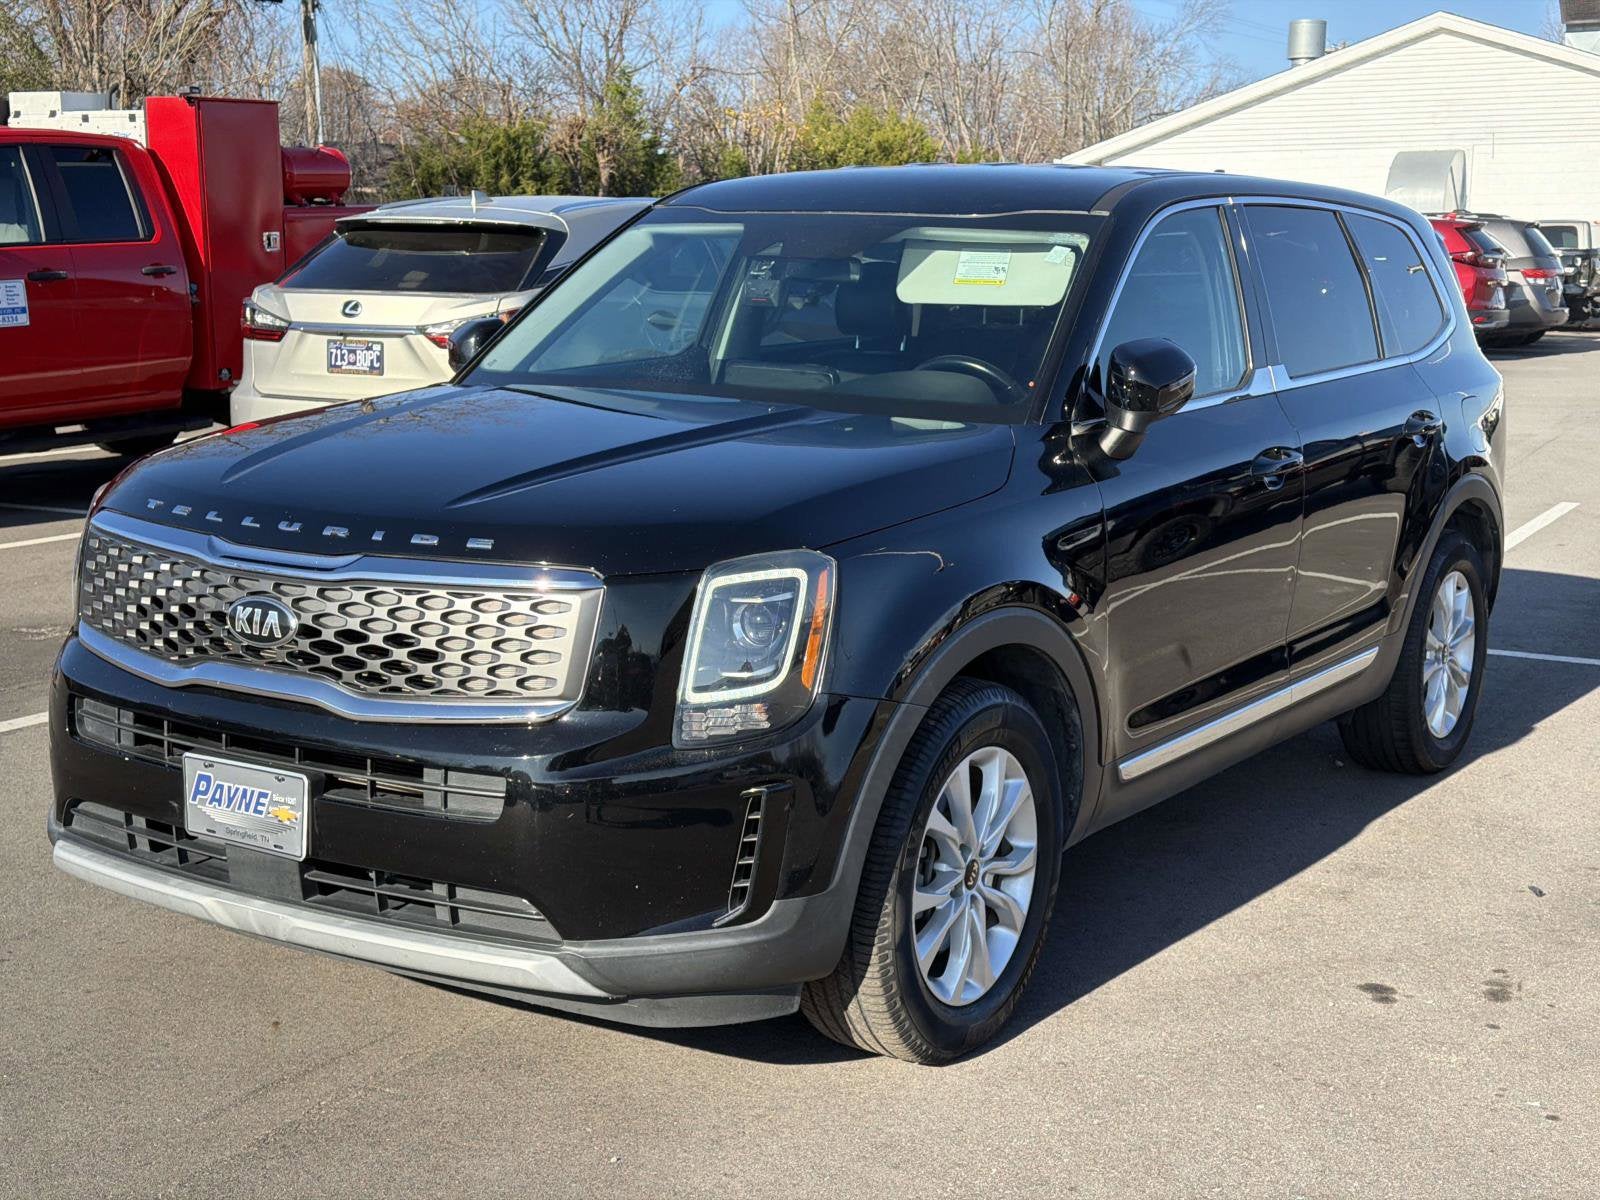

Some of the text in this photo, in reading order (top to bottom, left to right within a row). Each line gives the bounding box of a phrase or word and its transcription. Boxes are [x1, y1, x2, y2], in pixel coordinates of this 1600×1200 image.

[330, 349, 348, 366] 713
[147, 497, 496, 551] TELLURIDE
[235, 605, 282, 639] KIA
[189, 770, 272, 818] PAYNE
[966, 861, 979, 886] KIA
